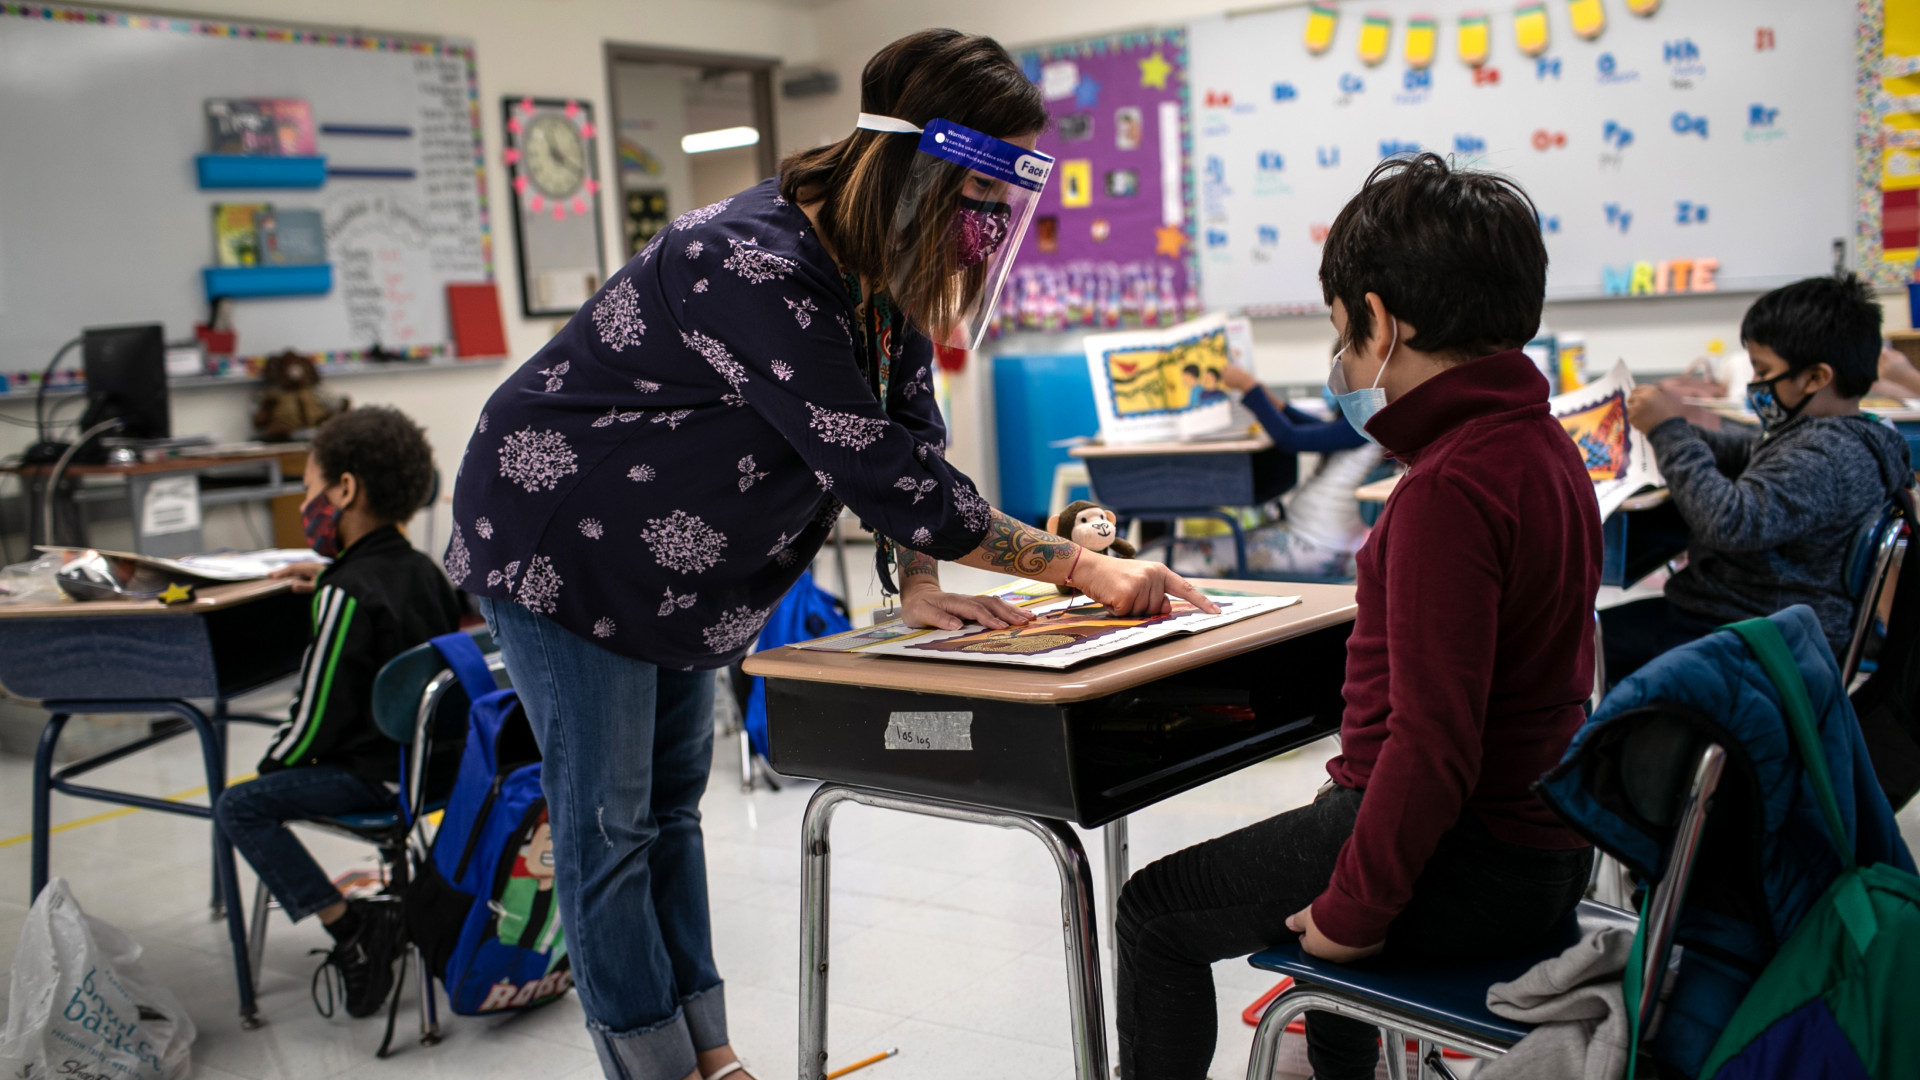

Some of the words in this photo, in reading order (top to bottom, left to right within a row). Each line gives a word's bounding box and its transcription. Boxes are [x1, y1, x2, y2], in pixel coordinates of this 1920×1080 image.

[947, 129, 972, 143] Warning:
[947, 147, 966, 158] prevent
[1021, 160, 1044, 177] Face
[1602, 257, 1719, 296] WRITE
